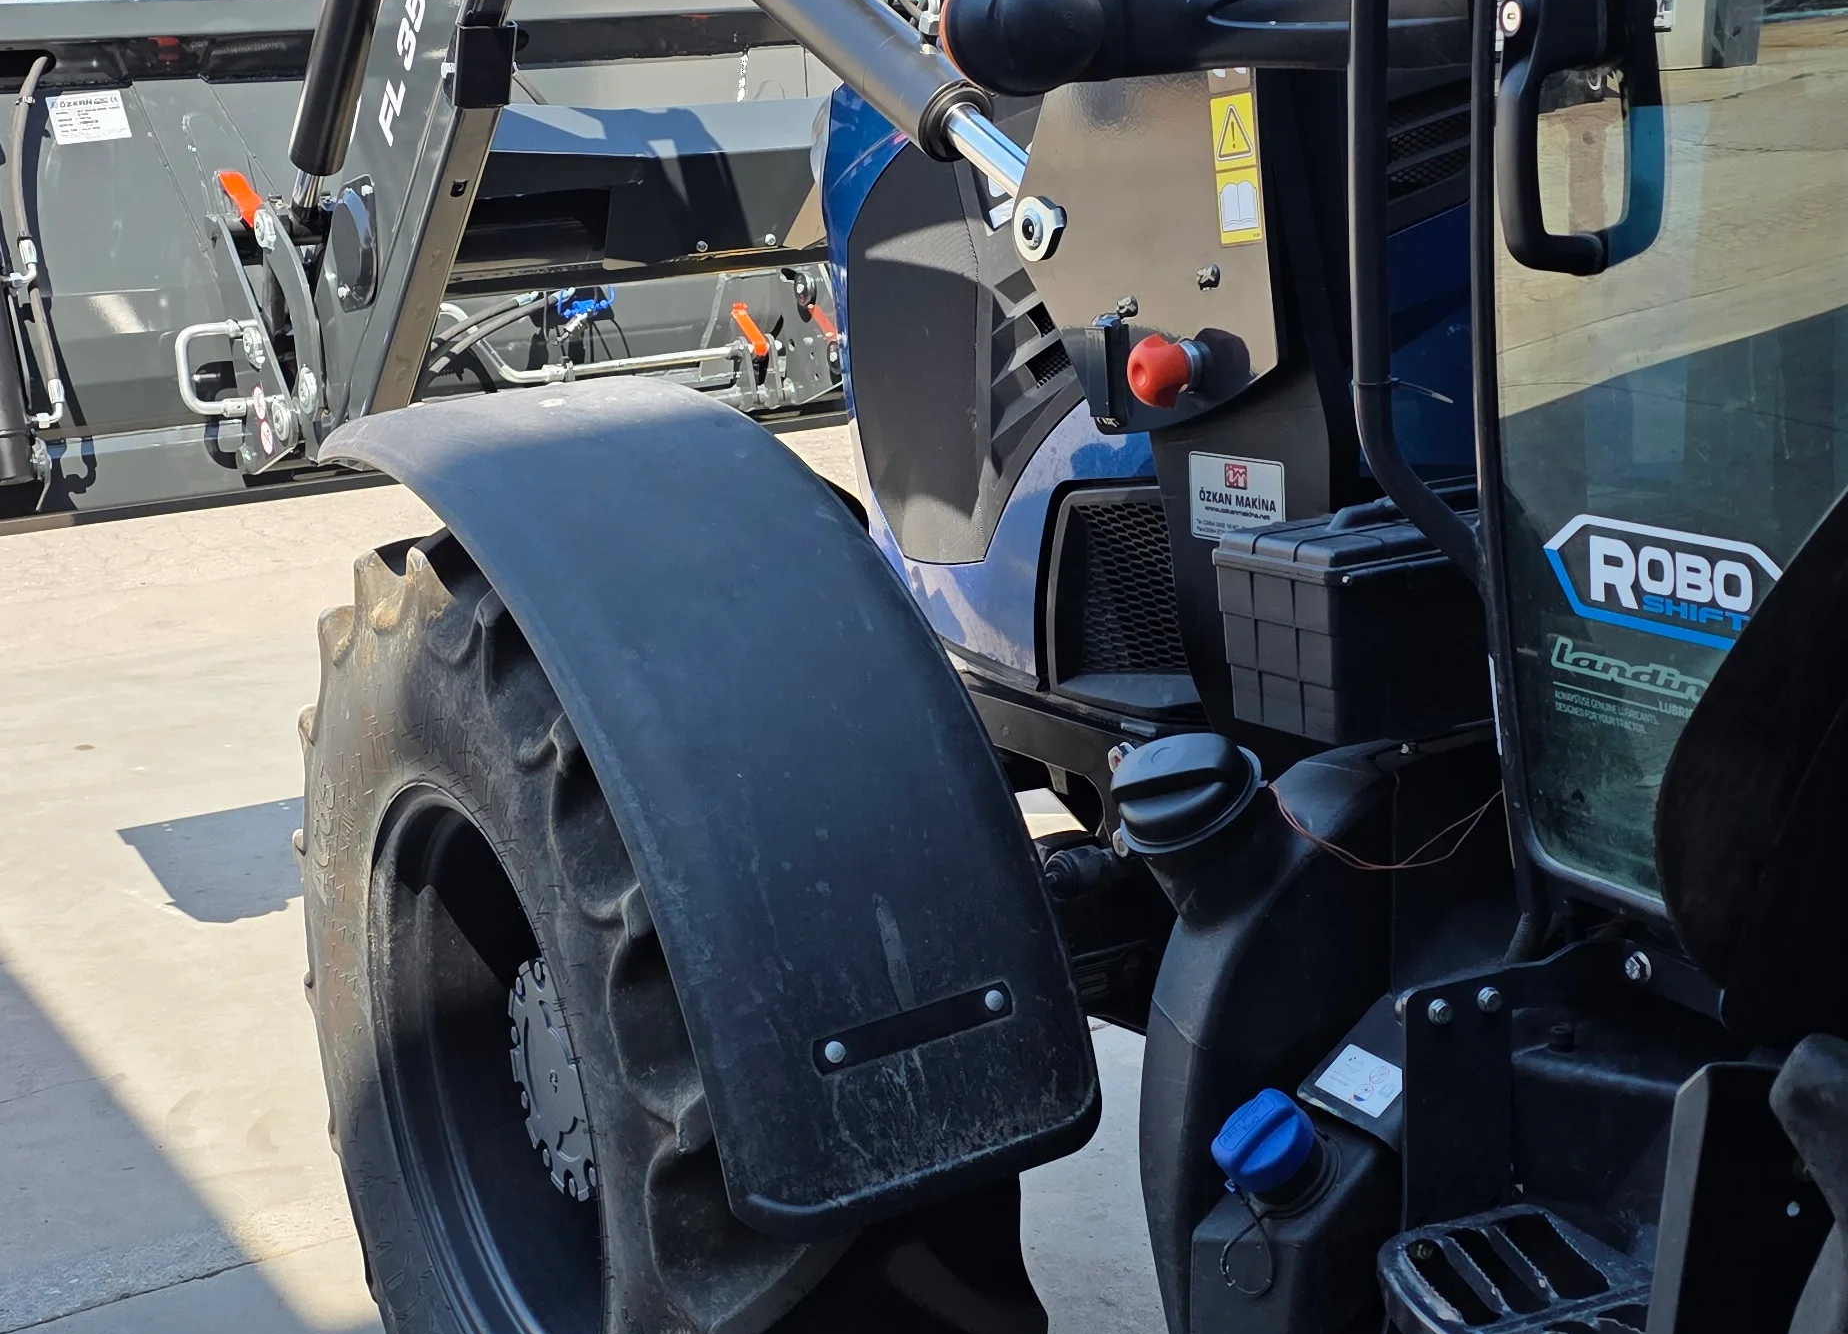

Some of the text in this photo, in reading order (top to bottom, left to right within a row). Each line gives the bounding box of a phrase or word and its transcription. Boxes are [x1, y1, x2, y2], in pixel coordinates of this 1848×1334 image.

[378, 78, 406, 147] FL
[1199, 487, 1277, 513] ÖZKAN MAKİNA
[1589, 534, 1753, 613] ROBO
[1642, 594, 1750, 632] SHIFT
